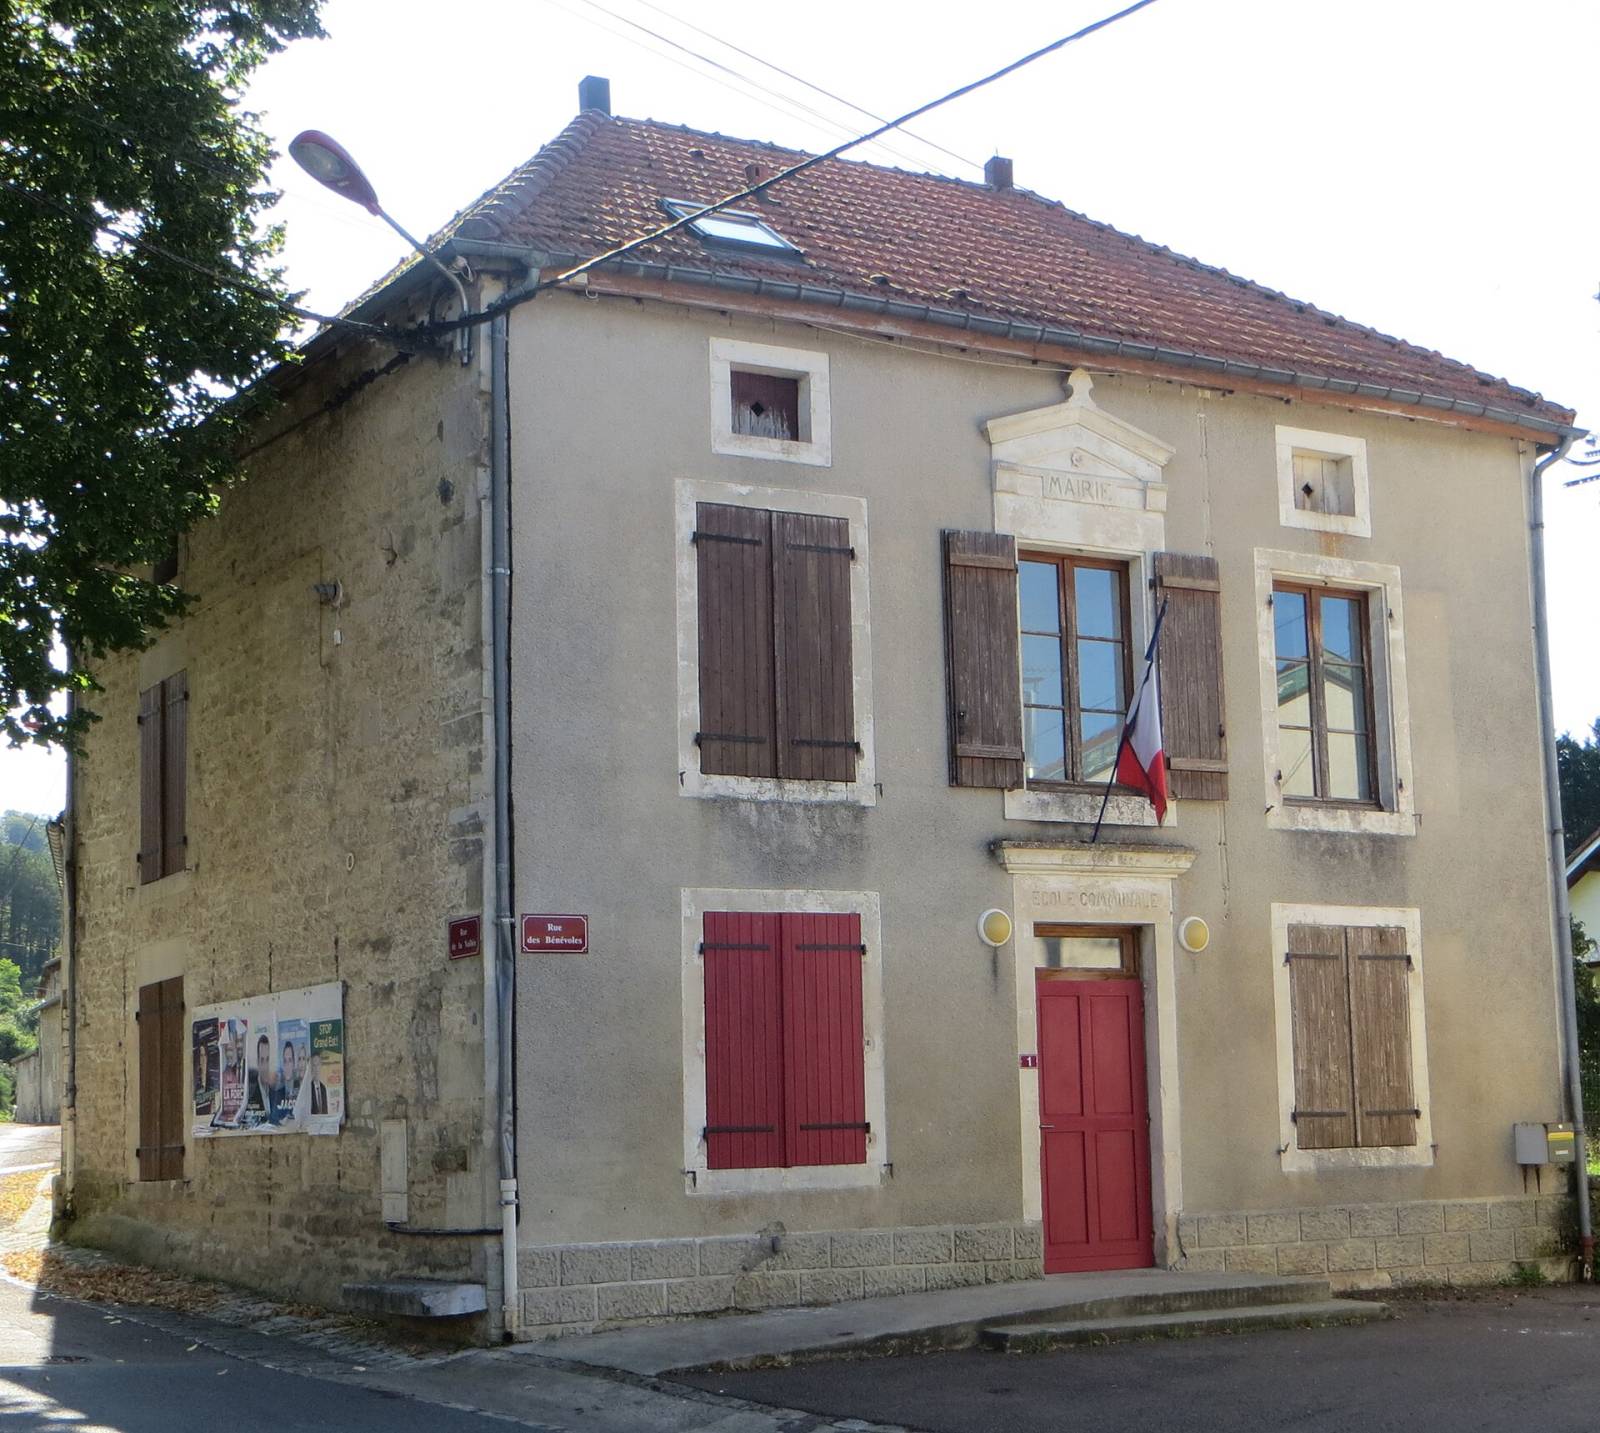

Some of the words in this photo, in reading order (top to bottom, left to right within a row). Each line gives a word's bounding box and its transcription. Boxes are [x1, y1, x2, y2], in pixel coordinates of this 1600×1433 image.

[1049, 476, 1112, 502] MAIRIE
[547, 923, 562, 932] Rue
[527, 936, 541, 944] des
[545, 935, 583, 945] Bénévoles
[319, 1023, 333, 1035] STOP
[1026, 1056, 1032, 1067] 1
